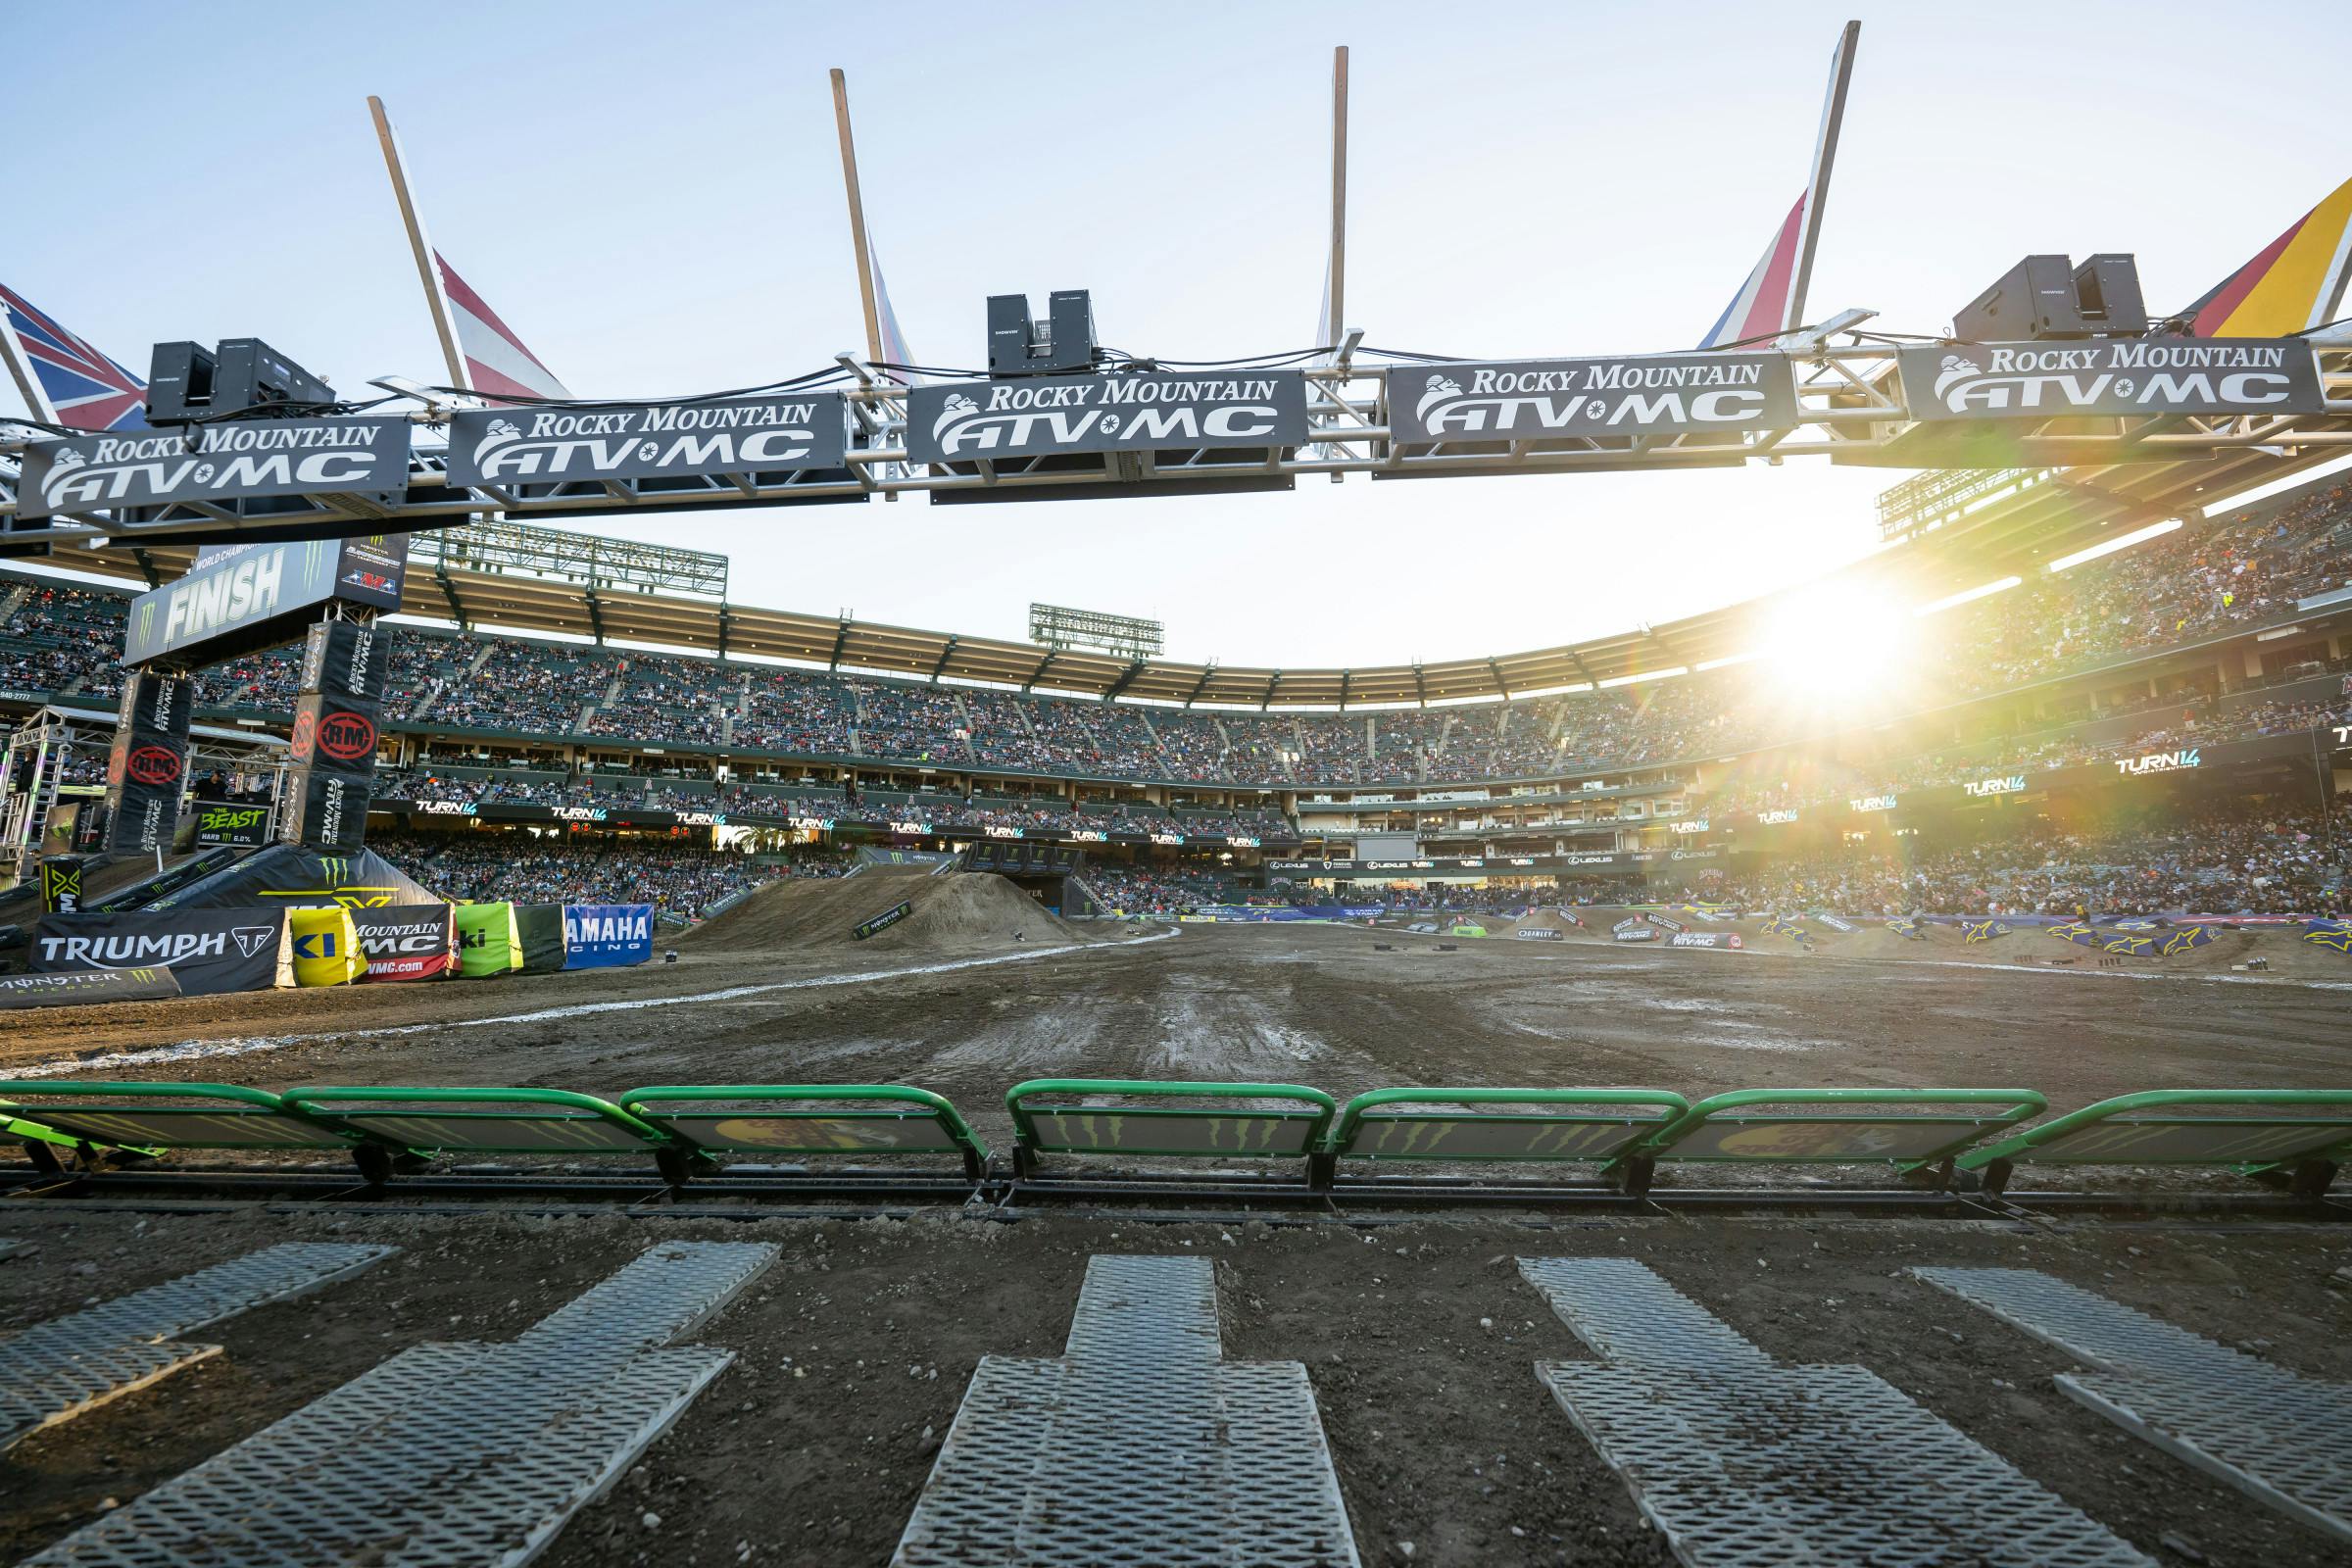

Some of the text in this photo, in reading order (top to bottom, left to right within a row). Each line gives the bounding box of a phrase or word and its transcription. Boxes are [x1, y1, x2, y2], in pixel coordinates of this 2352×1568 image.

[1988, 344, 2285, 372] ROCKY MOUNTAIN
[1469, 365, 1763, 394] ROCKY MOUNTAIN
[986, 379, 1278, 411] ROCKY MOUNTAIN
[528, 404, 816, 437] ROCKY MOUNTAIN
[91, 426, 380, 465] ROCKY MOUNTAIN
[196, 554, 220, 570] WORLD
[164, 547, 285, 643] FINISH
[341, 569, 397, 595] AMA
[2115, 748, 2200, 774] TURN14
[201, 810, 266, 831] BEAST
[416, 801, 478, 815] TURN14
[552, 807, 607, 820] TURN14
[356, 922, 443, 937] MOUNTAIN
[40, 932, 226, 969] TRIUMPH
